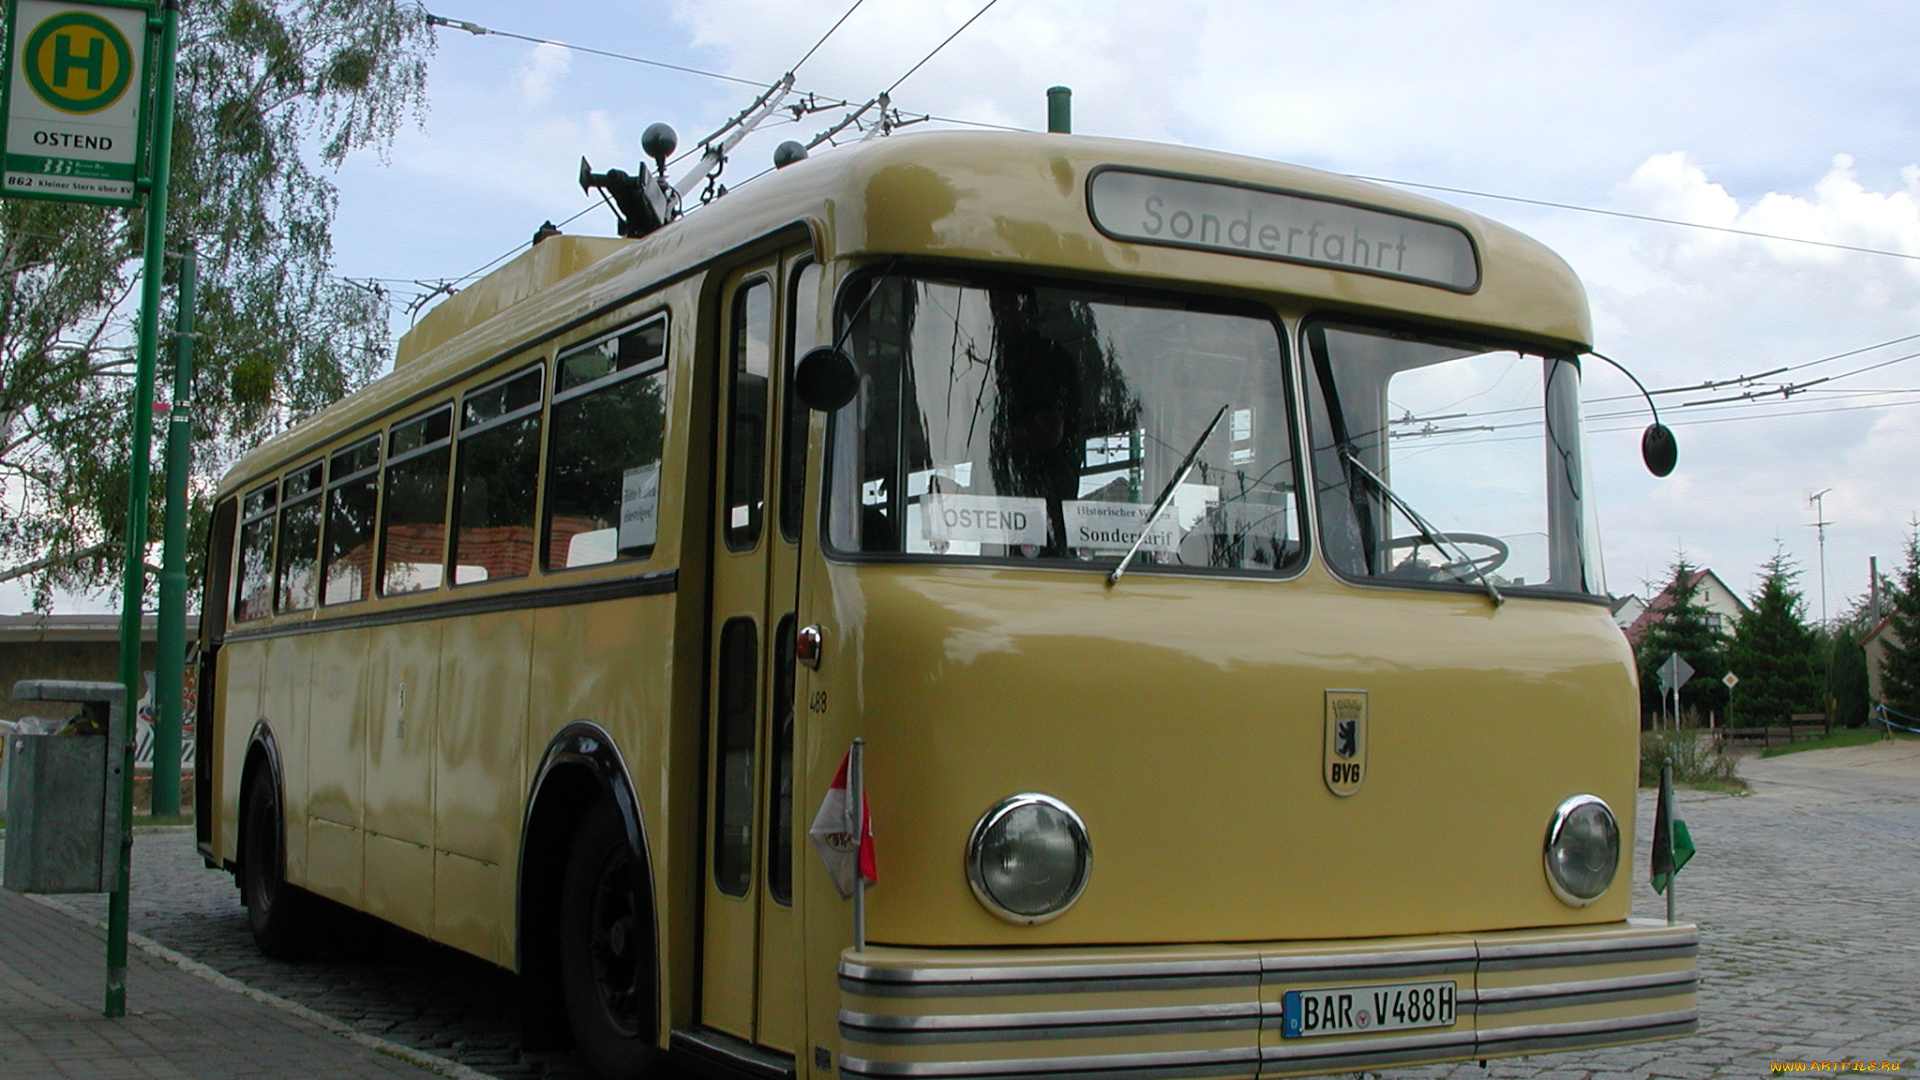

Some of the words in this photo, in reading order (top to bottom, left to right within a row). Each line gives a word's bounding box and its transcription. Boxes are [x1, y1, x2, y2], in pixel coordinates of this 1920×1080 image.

[53, 34, 105, 91] H
[33, 131, 113, 151] OSTEND
[8, 177, 33, 187] 862
[38, 180, 70, 190] Kleiner
[72, 182, 96, 192] Stern
[1142, 195, 1407, 272] Sonderfahrt
[944, 508, 1027, 531] OSTEND
[1077, 506, 1137, 518] Historischer
[809, 691, 827, 713] 488
[1332, 763, 1360, 783] BVG
[1304, 994, 1353, 1030] BAR
[1374, 986, 1453, 1025] V488H
[1291, 1019, 1298, 1029] D
